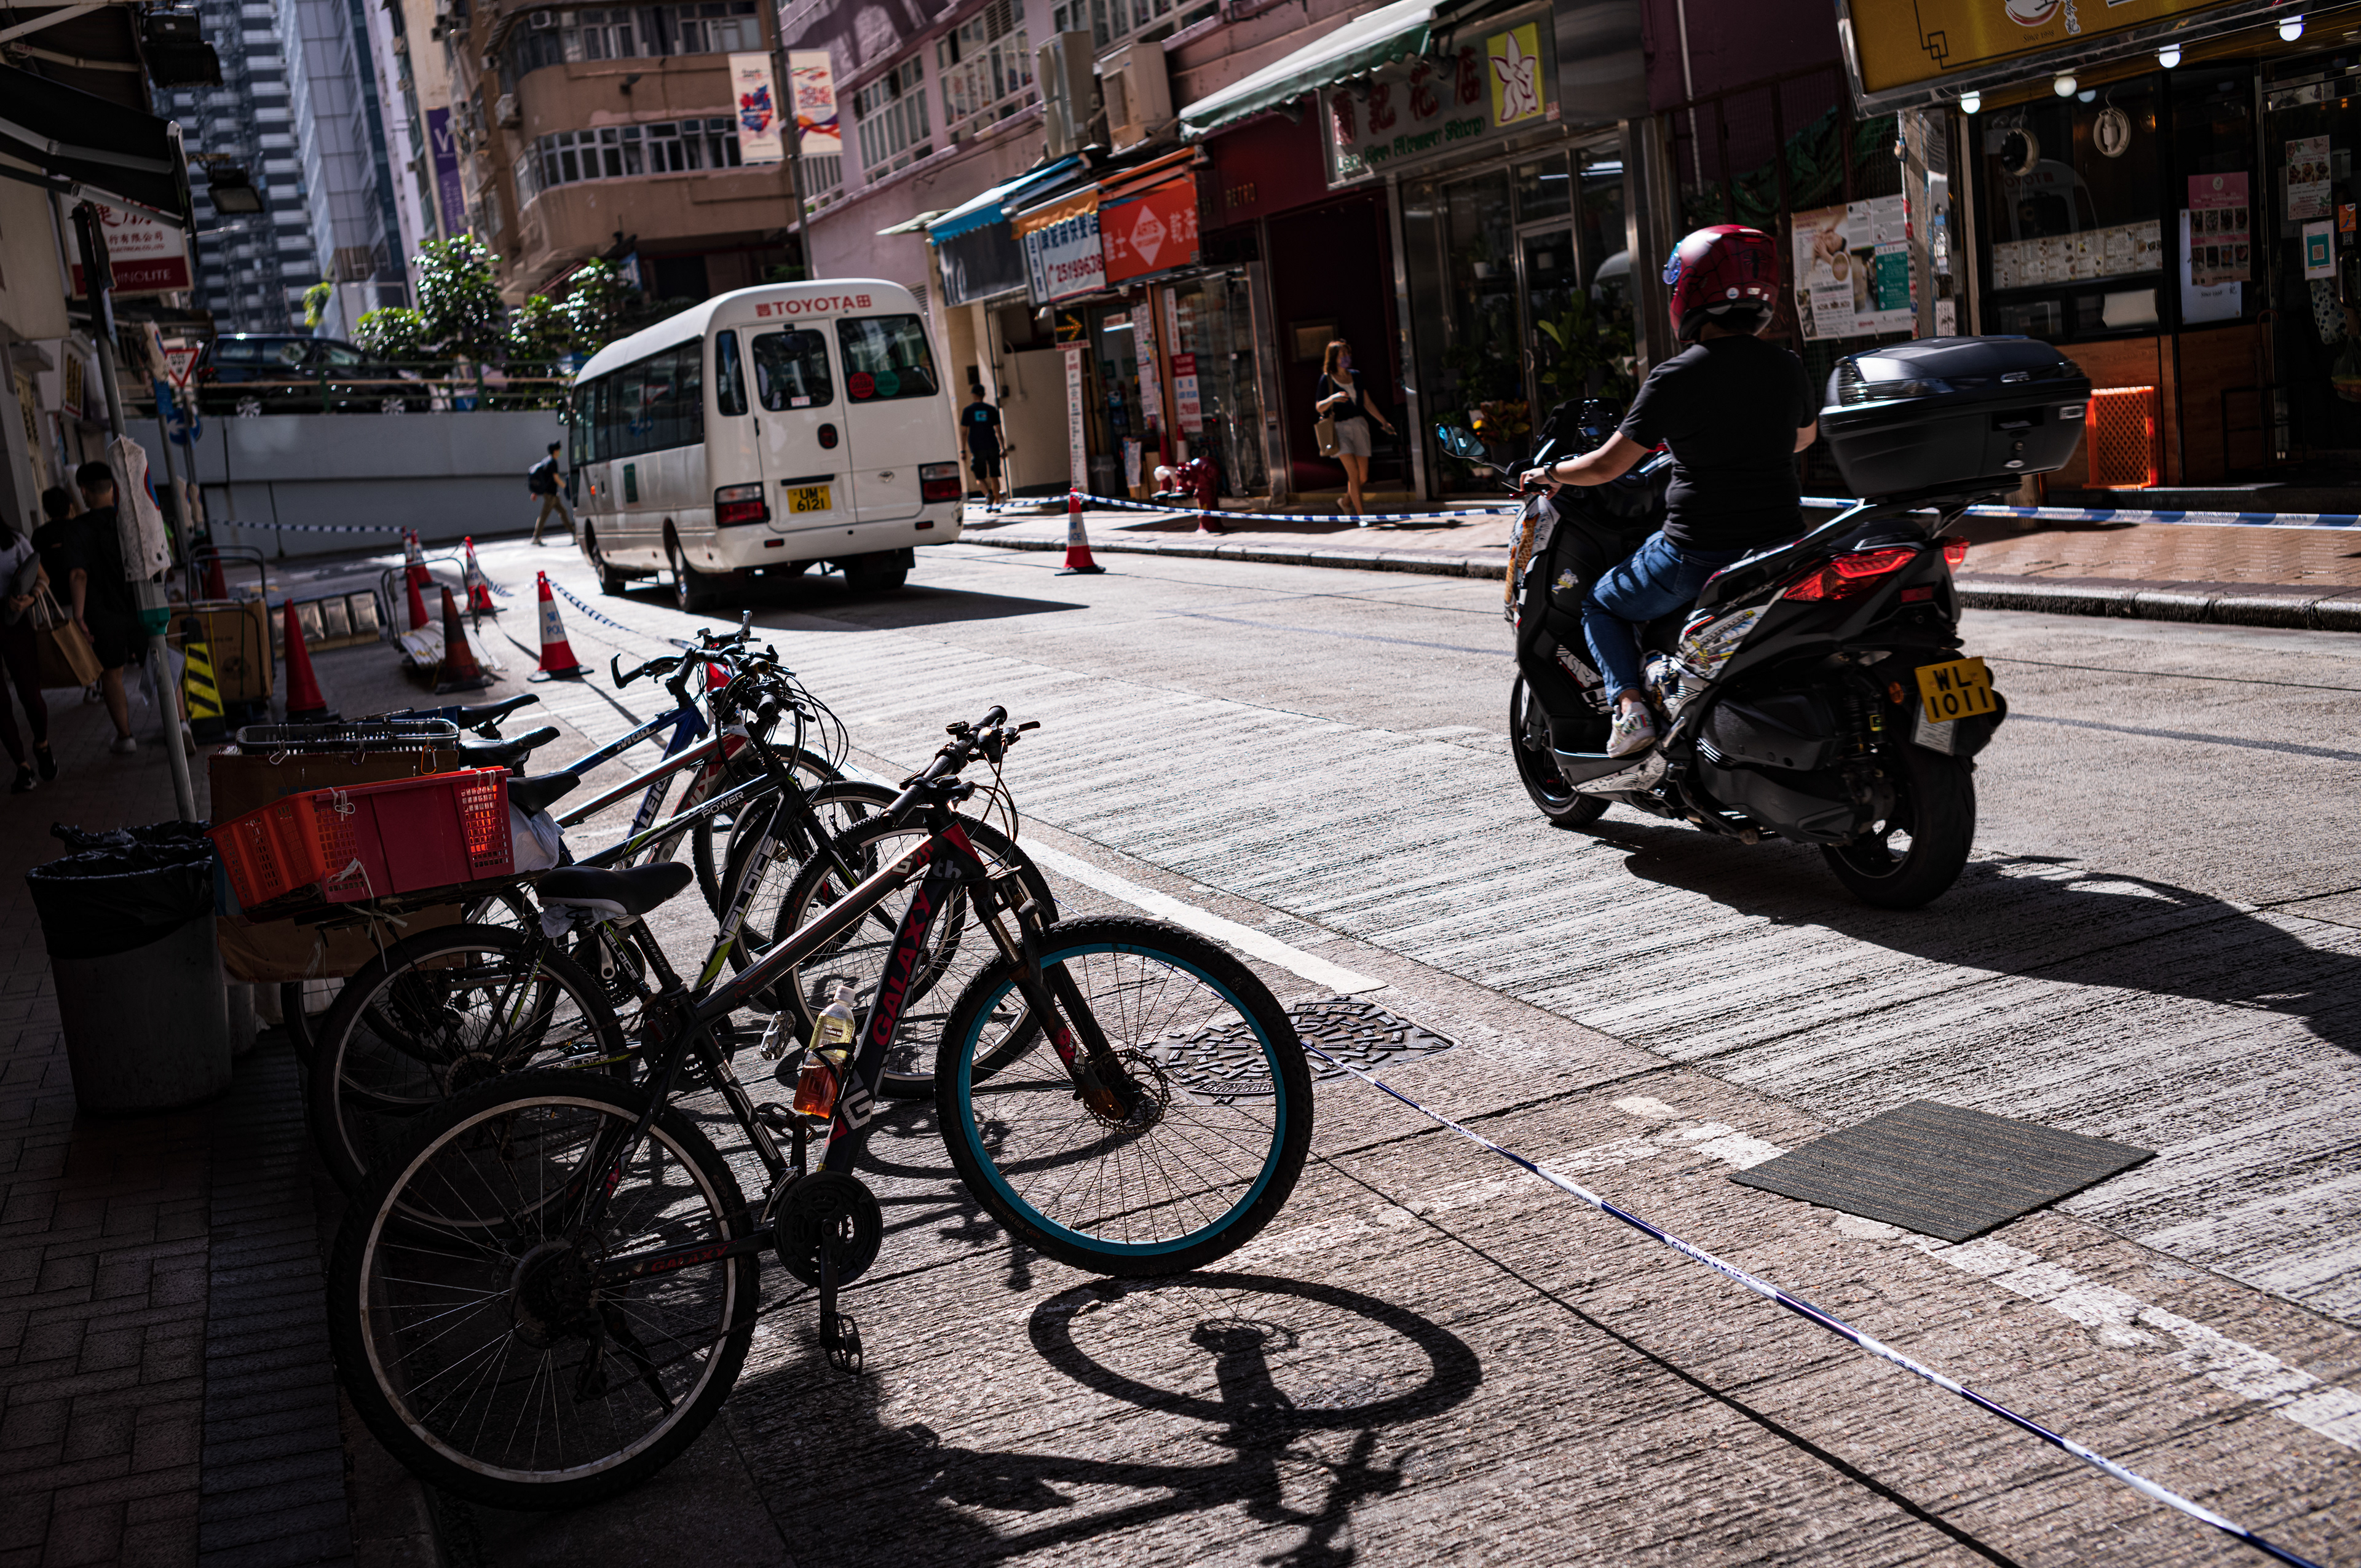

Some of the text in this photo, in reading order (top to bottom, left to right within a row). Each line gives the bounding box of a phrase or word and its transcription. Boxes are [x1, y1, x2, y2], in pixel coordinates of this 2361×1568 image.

[1445, 116, 1487, 142] Shop
[797, 498, 825, 512] 6121
[799, 487, 819, 500] UM
[1932, 666, 1973, 692] WL
[1930, 686, 1989, 719] 1011
[701, 791, 745, 818] POWER
[716, 834, 779, 948] VELOCE
[603, 925, 639, 981] VELOCE
[639, 929, 668, 972] BONTRAGER
[520, 958, 541, 1000] POWER
[872, 889, 931, 1045] GALAXY
[651, 1245, 728, 1273] GALAXY
